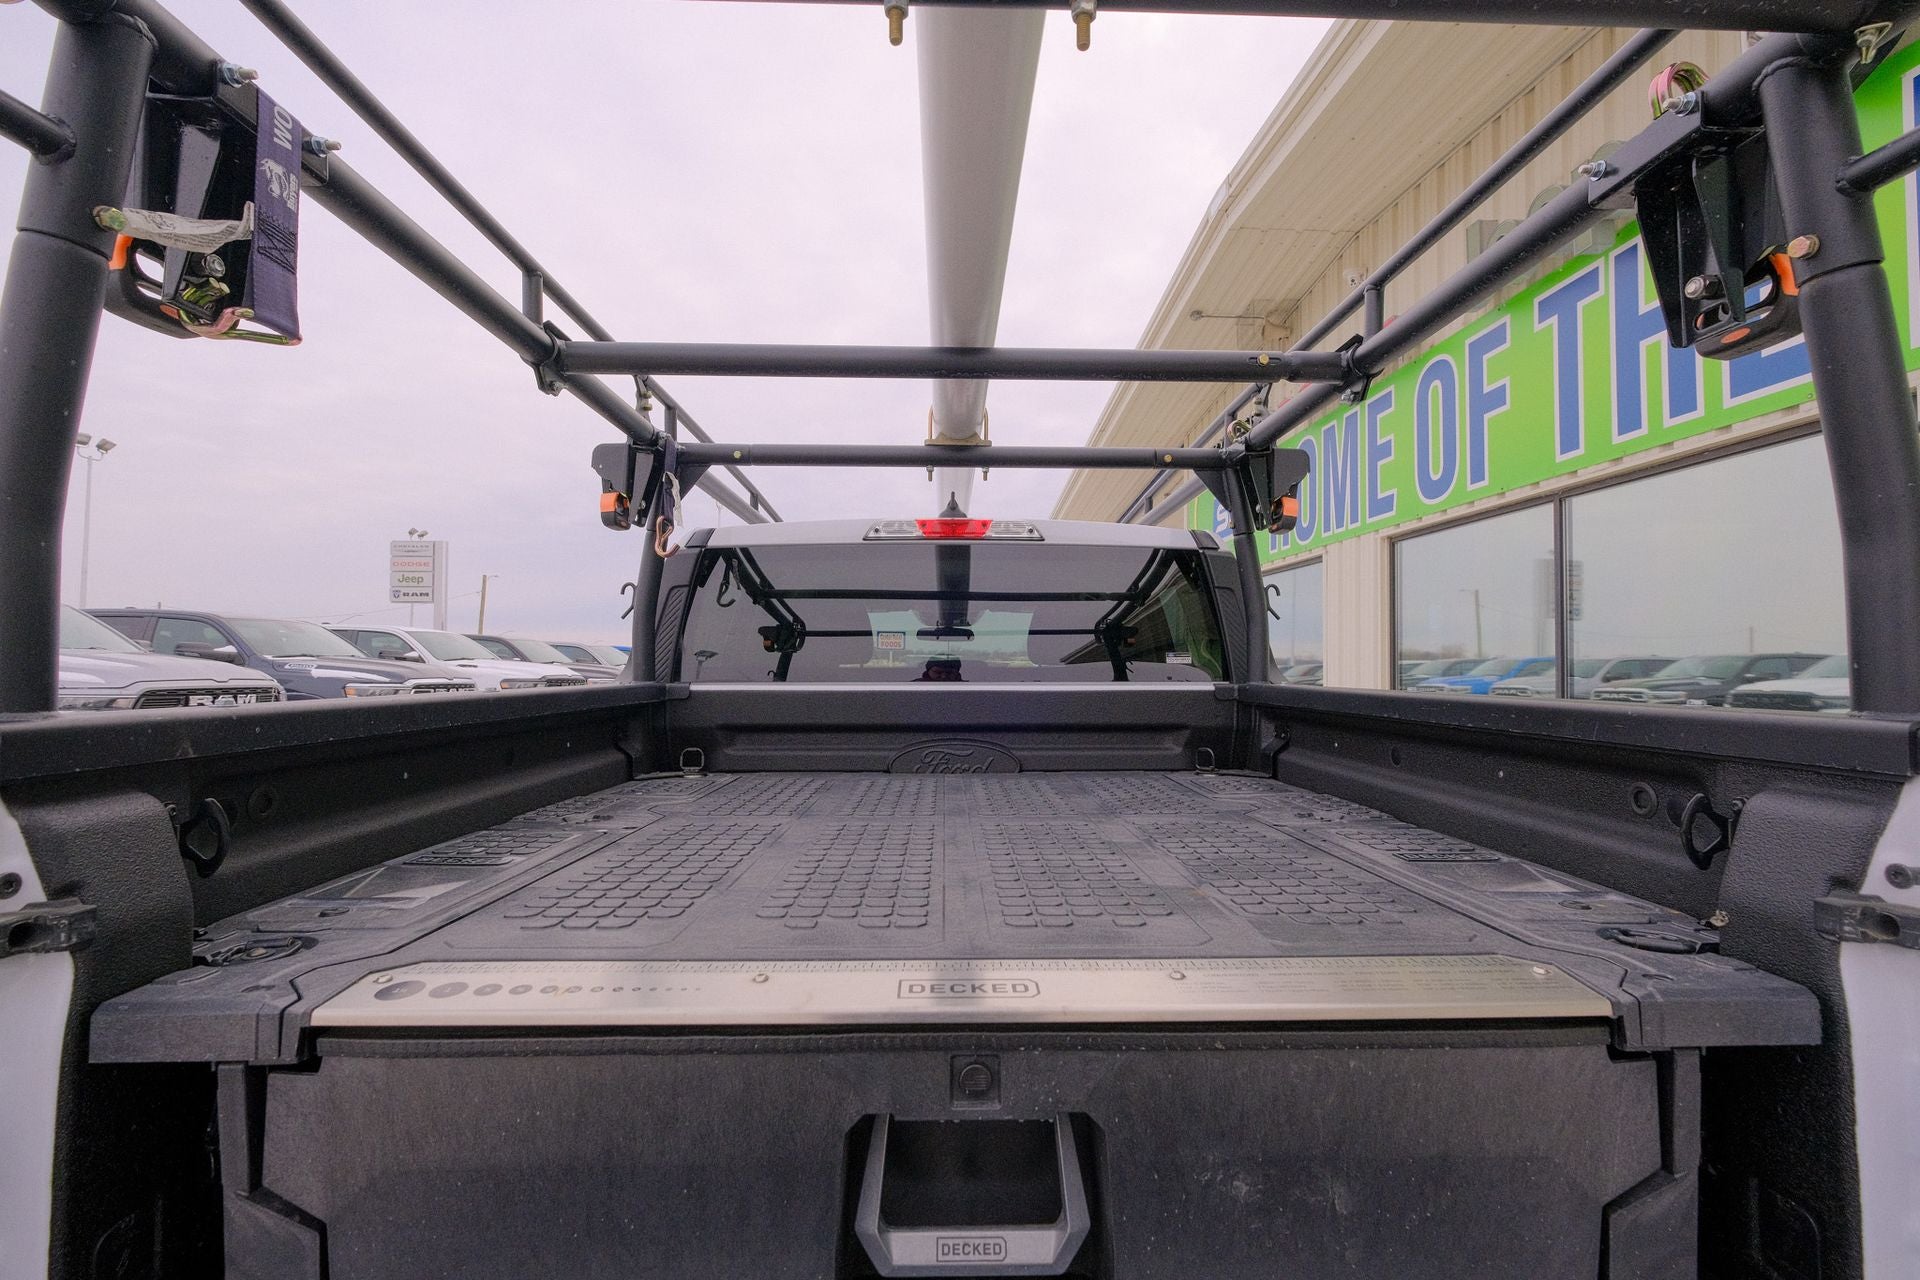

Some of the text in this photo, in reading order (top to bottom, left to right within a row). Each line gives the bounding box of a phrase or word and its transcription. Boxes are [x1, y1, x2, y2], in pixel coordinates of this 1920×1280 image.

[1269, 236, 1813, 554] OME OF TH
[398, 574, 424, 584] Jeep
[908, 983, 1030, 994] DECKED
[941, 1242, 1003, 1257] DECKED
